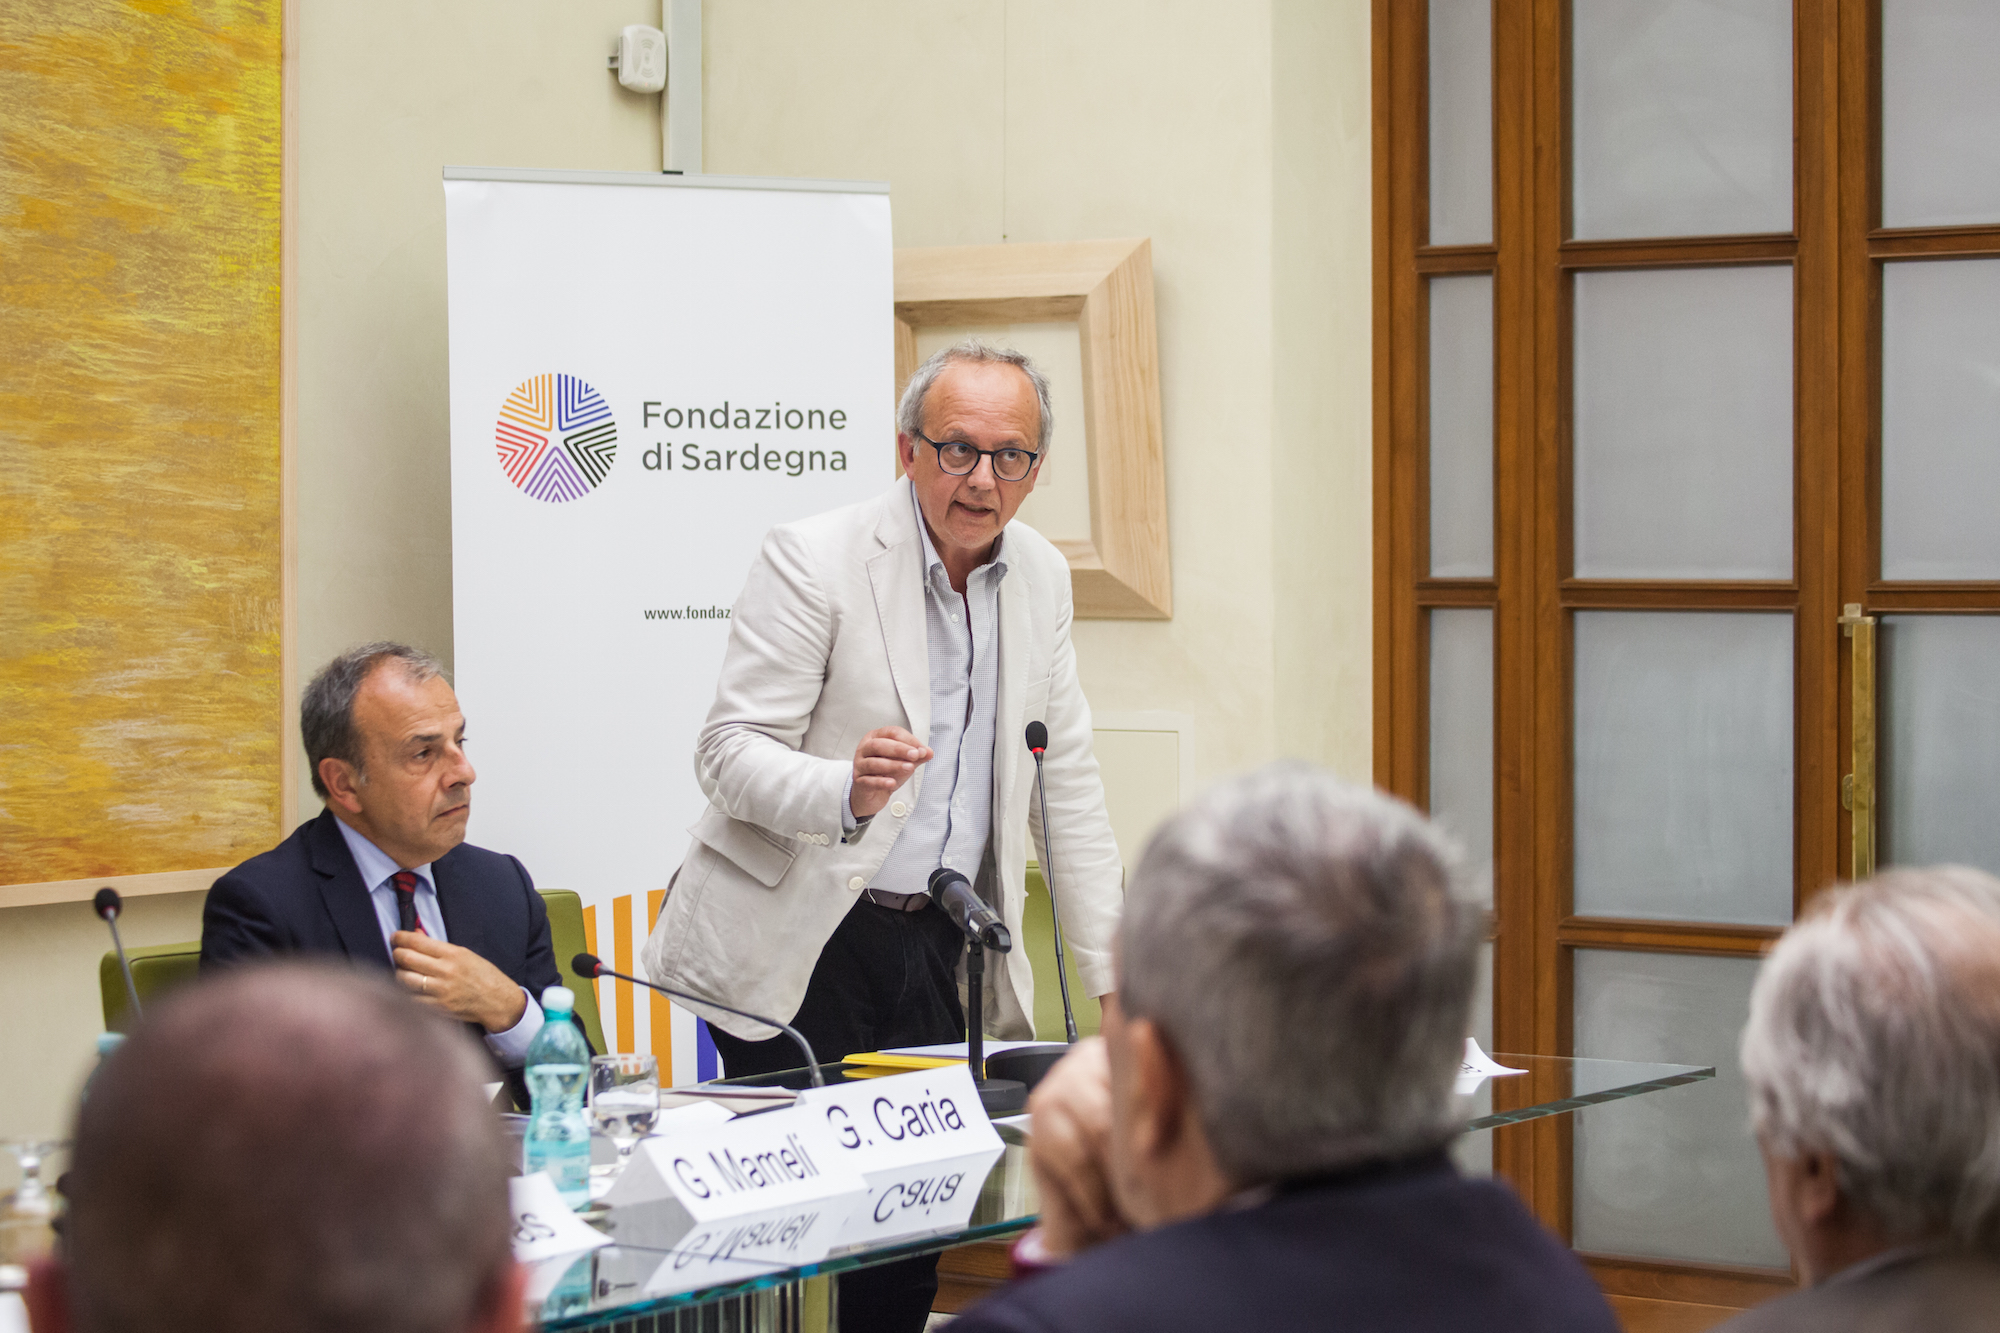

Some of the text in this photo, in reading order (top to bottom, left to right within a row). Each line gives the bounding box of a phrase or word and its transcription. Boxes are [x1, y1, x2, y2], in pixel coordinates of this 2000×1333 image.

[642, 400, 848, 431] Fondazione
[641, 441, 848, 478] di Sardegna
[643, 605, 735, 620] www.fondaz
[826, 1088, 967, 1150] G. Caria
[673, 1132, 820, 1199] G. Mameli
